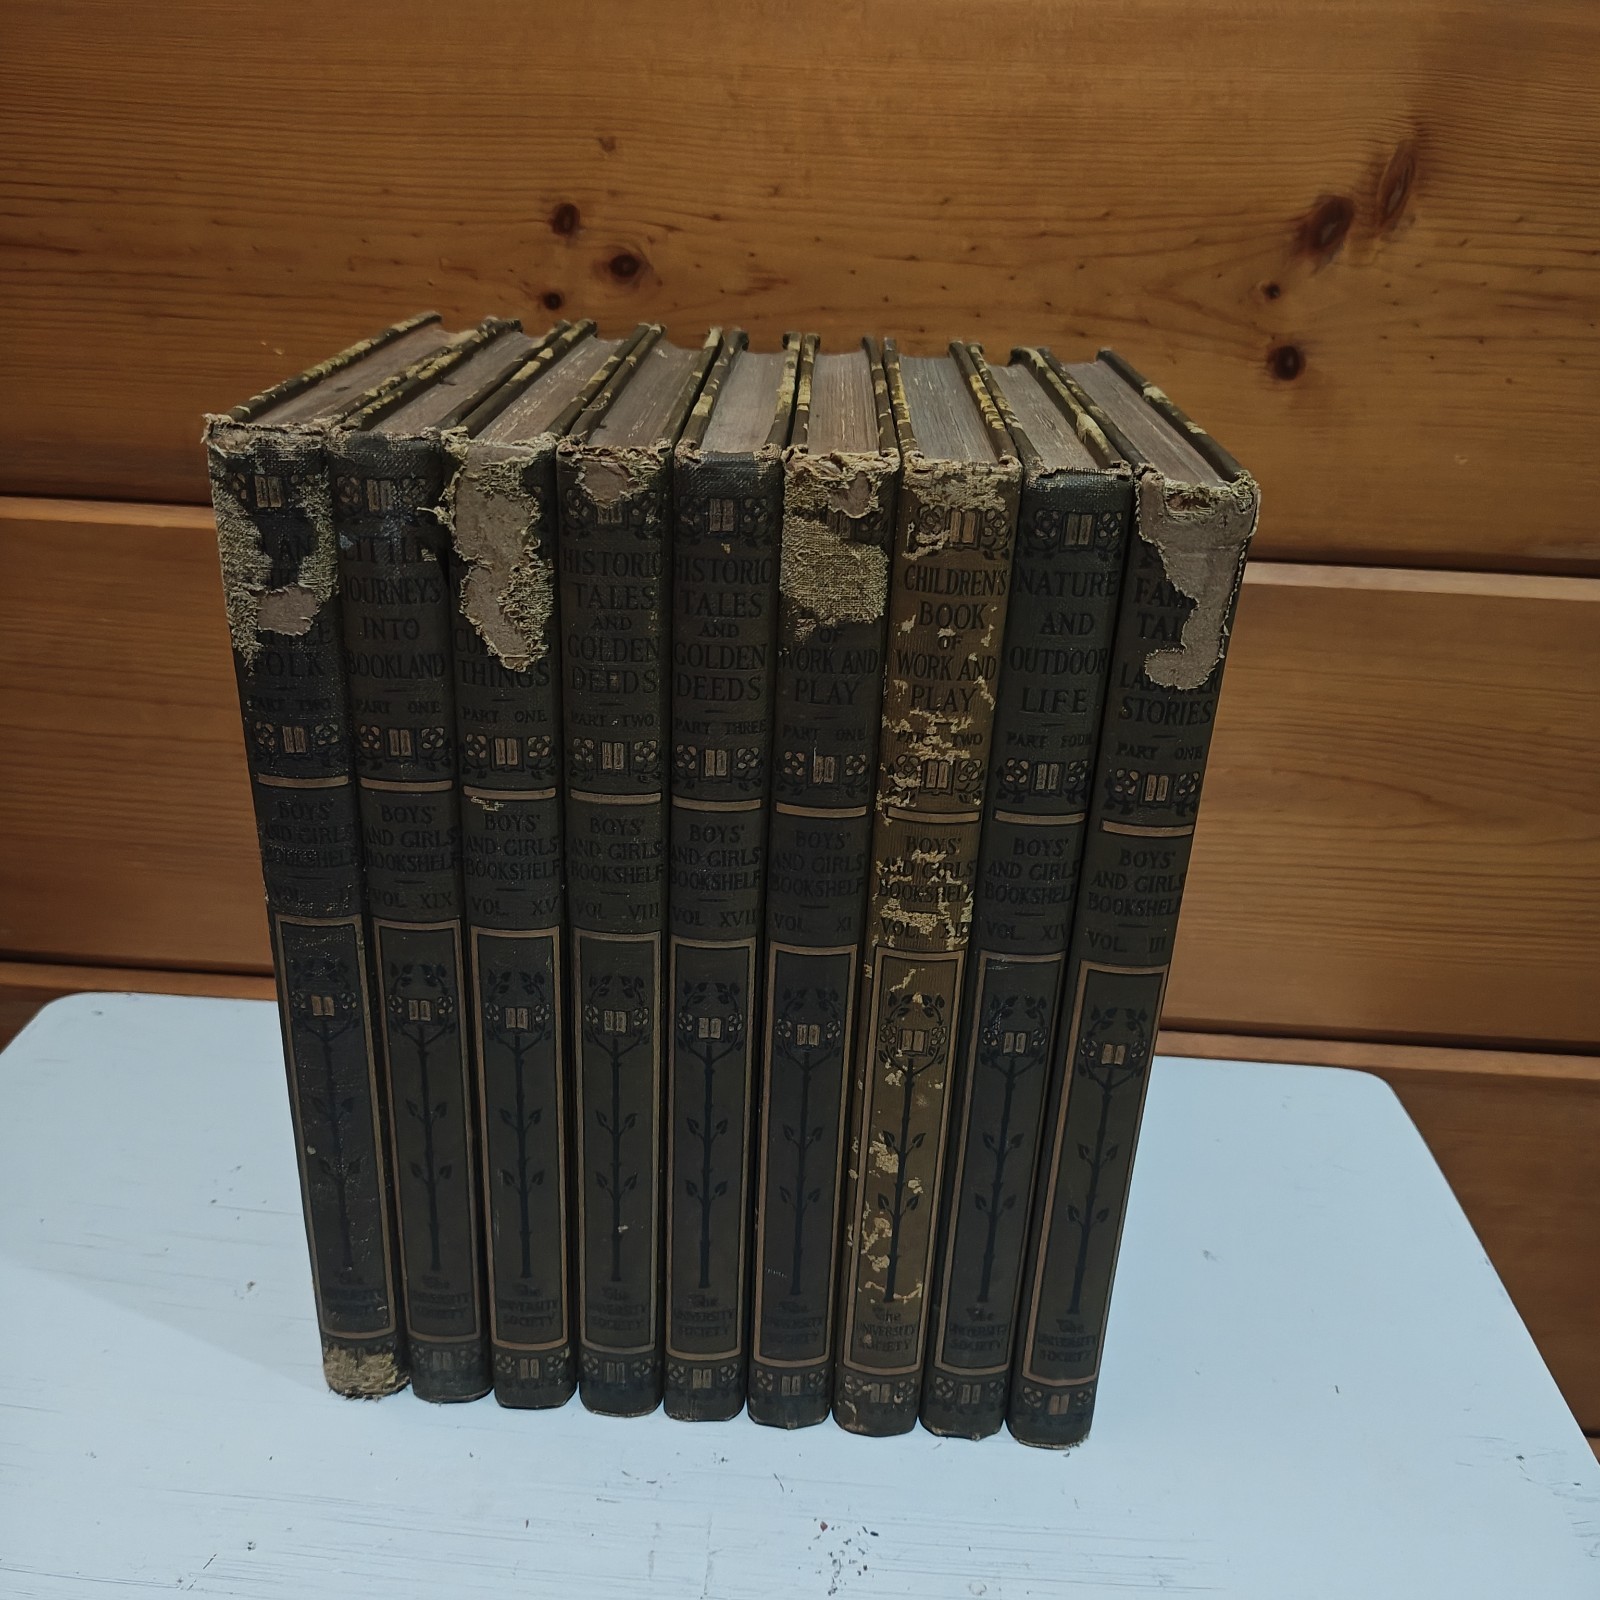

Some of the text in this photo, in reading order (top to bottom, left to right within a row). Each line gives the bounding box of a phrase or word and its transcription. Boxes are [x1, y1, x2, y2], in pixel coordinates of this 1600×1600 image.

[562, 549, 664, 578] HISTORIC
[674, 556, 773, 585] HISTORIC
[343, 575, 442, 606] JOURNEYS
[904, 564, 1008, 597] CHILDREN'S
[1016, 565, 1119, 598] NATURE
[571, 582, 656, 611] TALES
[680, 589, 763, 618] TALES
[590, 616, 632, 632] AND
[918, 600, 988, 630] BOOK
[1038, 612, 1095, 636] AND
[361, 616, 421, 641] INTO
[697, 623, 740, 638] AND
[818, 629, 842, 644] OF
[567, 633, 661, 663] GOLDEN
[937, 635, 962, 650] OF
[349, 652, 446, 679] BOOKLAND
[673, 641, 768, 671] GOLDEN
[778, 647, 880, 675] WORK AND
[896, 650, 998, 682] WORK AND
[1008, 646, 1110, 675] OUTDOOR
[459, 660, 550, 689] THINGS
[571, 667, 658, 695] DEEDS
[676, 672, 763, 702] DEEDS
[794, 678, 861, 706] PLAY
[911, 684, 979, 713] PLAY
[356, 700, 442, 714] PART ONE
[1020, 687, 1089, 713] LIFE
[1118, 696, 1213, 726] STORIES
[461, 706, 548, 723] PART ONE
[570, 711, 655, 728] PART TWO
[673, 718, 768, 735] PART THREE
[781, 724, 866, 741] PART ONE
[951, 732, 983, 748] TWO
[1006, 731, 1093, 748] PART FOUR
[1116, 741, 1204, 761] PART ONE
[365, 825, 394, 847] AND
[466, 834, 498, 856] AND
[574, 838, 602, 858] AND
[671, 846, 699, 867] AND
[466, 858, 560, 881] BOOKSHELF
[570, 863, 664, 885] BOOKSHELF
[774, 852, 805, 873] AND
[987, 859, 1022, 879] AND
[670, 869, 761, 892] BOOKSHELF
[768, 875, 864, 898] BOOKSHELF
[1090, 870, 1127, 890] AND
[419, 890, 453, 909] XIX
[530, 895, 558, 916] XV
[628, 903, 660, 920] VIII
[836, 913, 852, 932] XI
[1149, 935, 1168, 953] III
